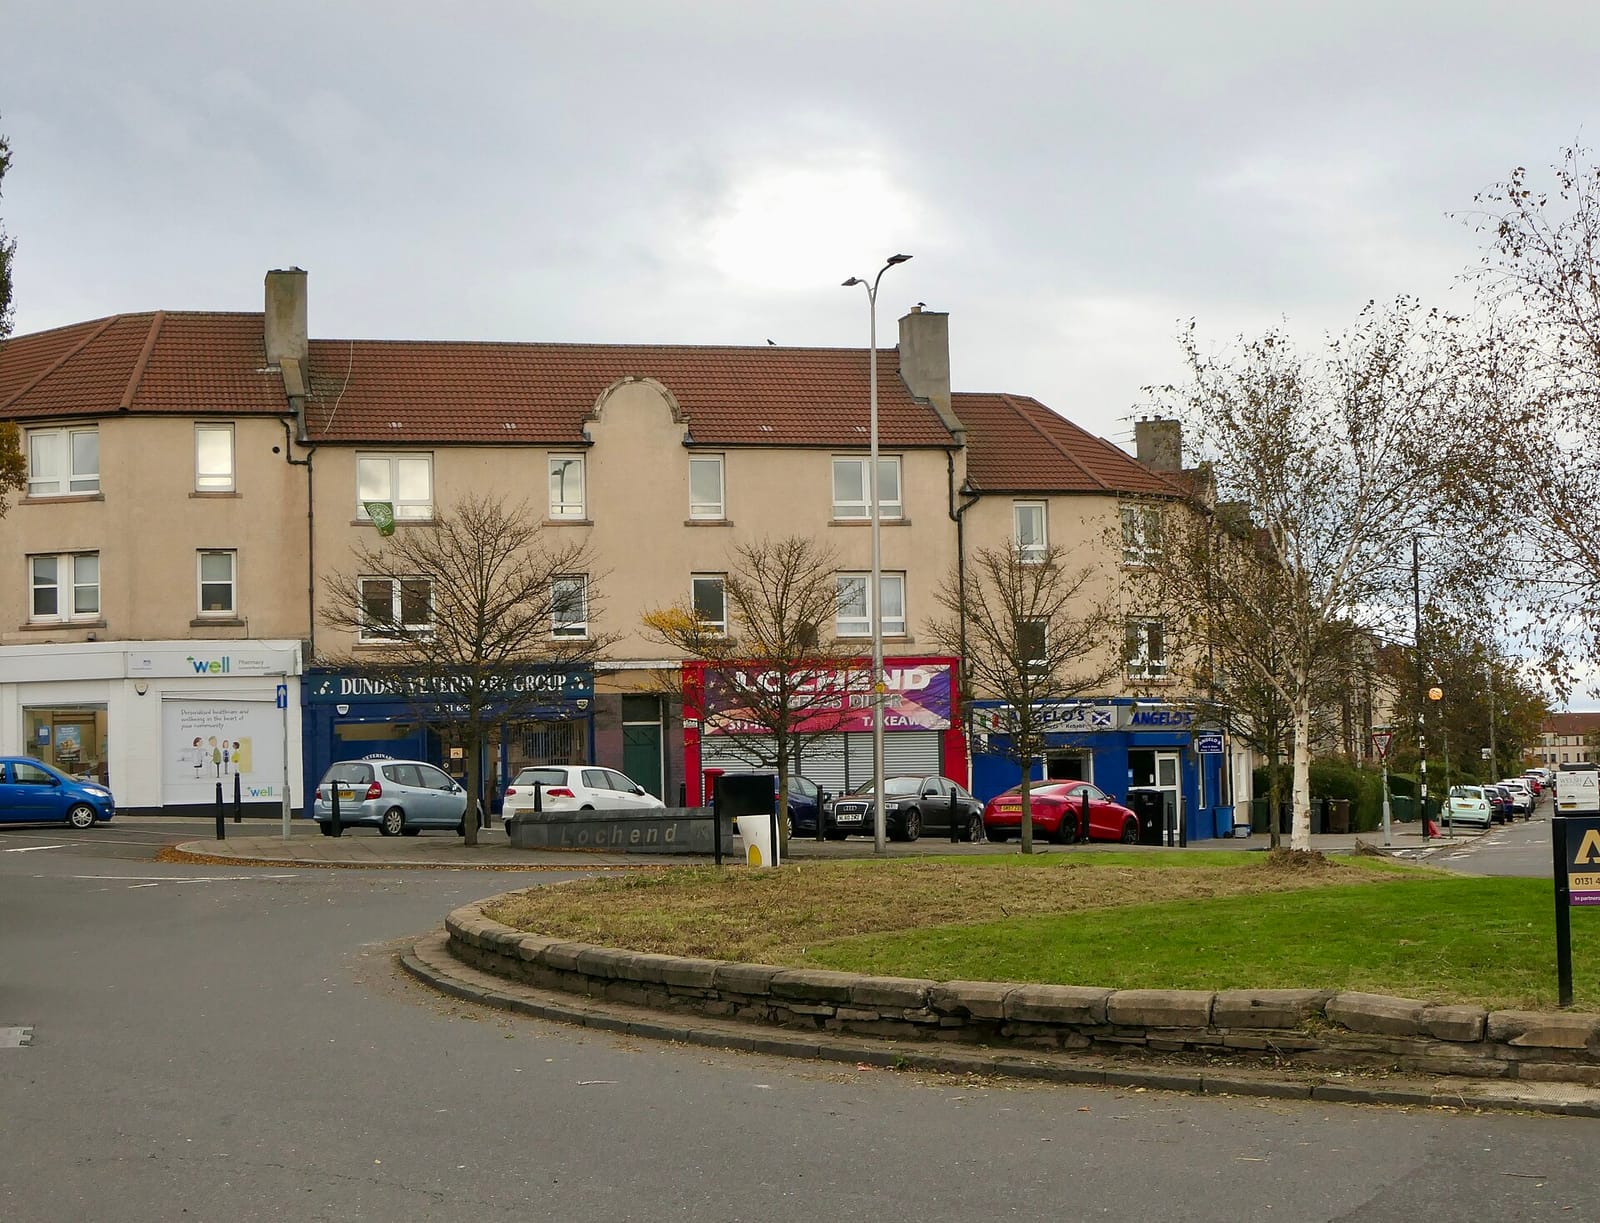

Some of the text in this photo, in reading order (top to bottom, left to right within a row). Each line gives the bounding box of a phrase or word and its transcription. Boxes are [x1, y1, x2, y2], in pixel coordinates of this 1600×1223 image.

[193, 656, 230, 674] well
[512, 674, 567, 692] GROUP
[735, 669, 931, 692] LOCHEND
[1010, 709, 1087, 723] AGELO'S
[1131, 711, 1193, 725] ANGELO'S
[250, 786, 272, 797] well
[560, 823, 678, 846] Lochend
[1574, 877, 1593, 886] 0131
